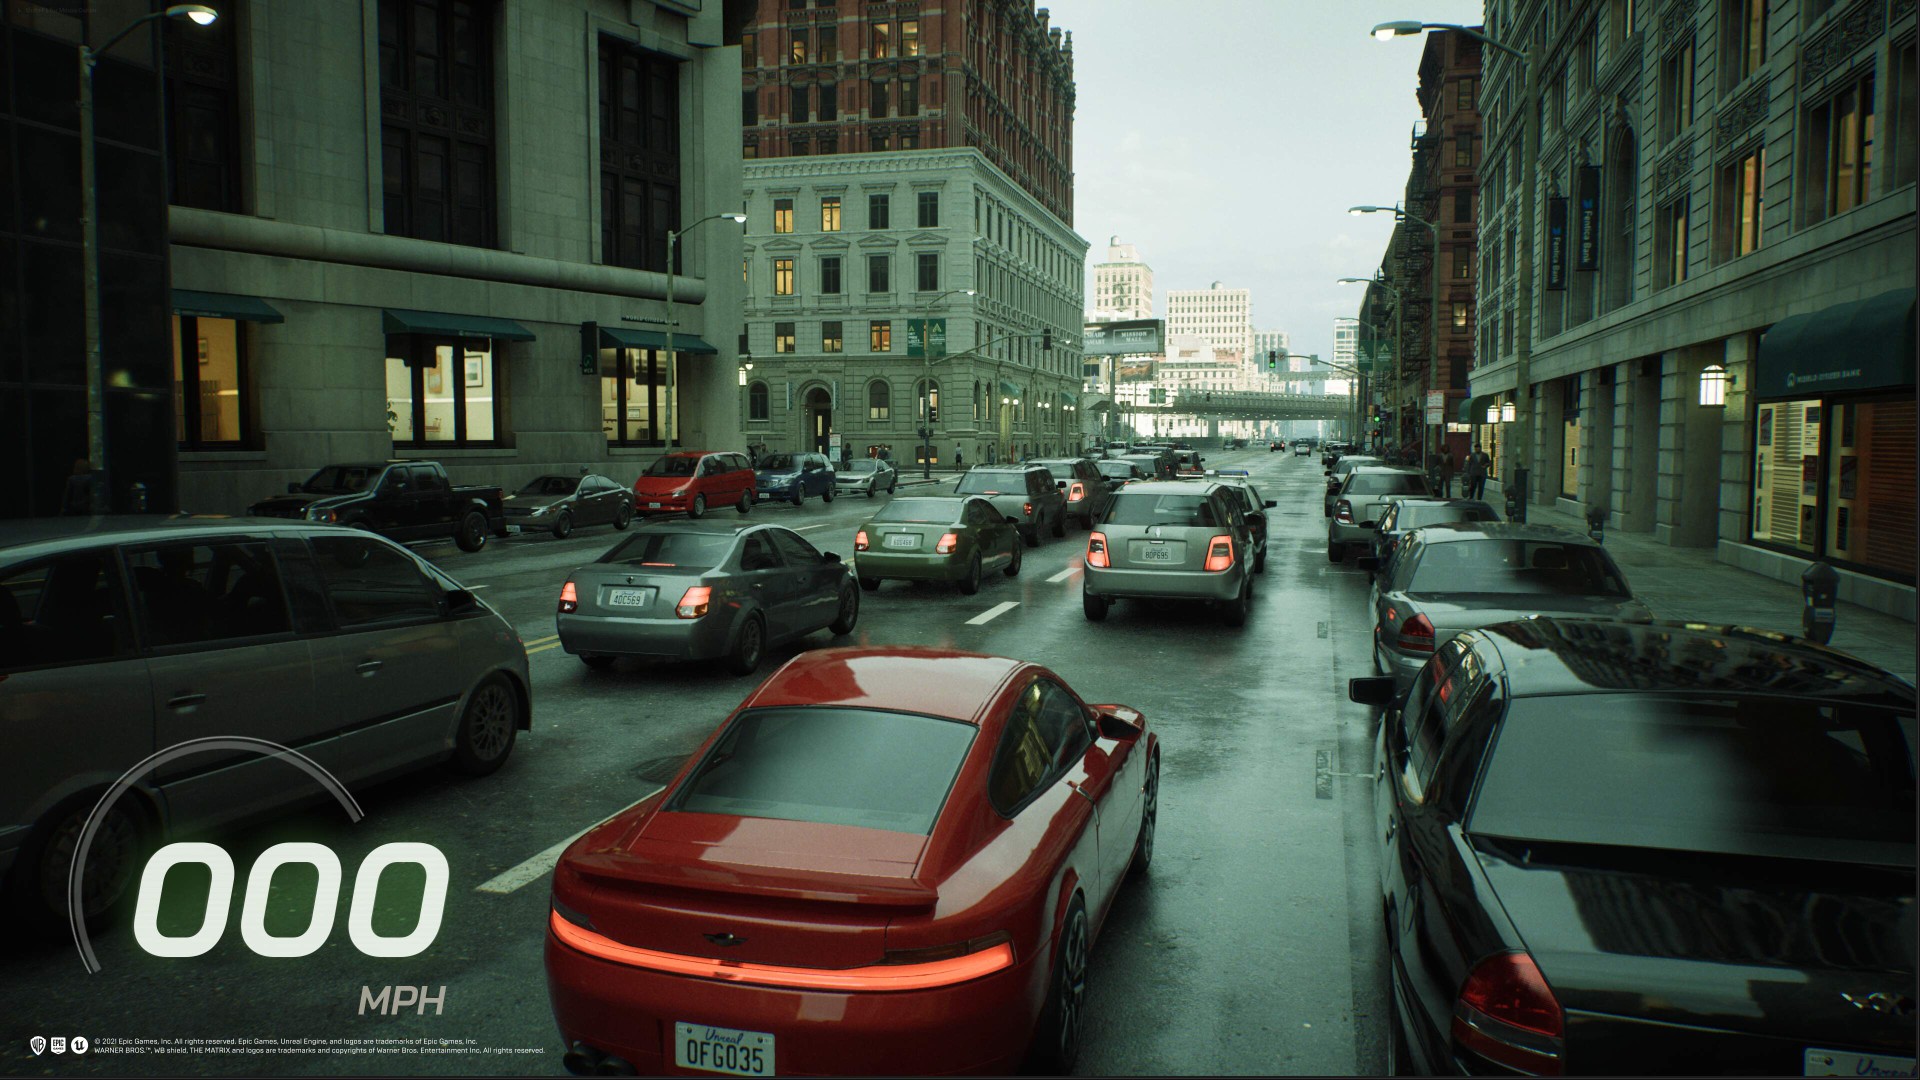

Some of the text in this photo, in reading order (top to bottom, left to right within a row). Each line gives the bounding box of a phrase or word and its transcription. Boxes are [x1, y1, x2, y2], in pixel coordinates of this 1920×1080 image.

[1582, 210, 1593, 263] Fentica Bank
[1551, 264, 1560, 284] Bank
[1842, 369, 1862, 378] BANK
[705, 1028, 744, 1045] Unreal
